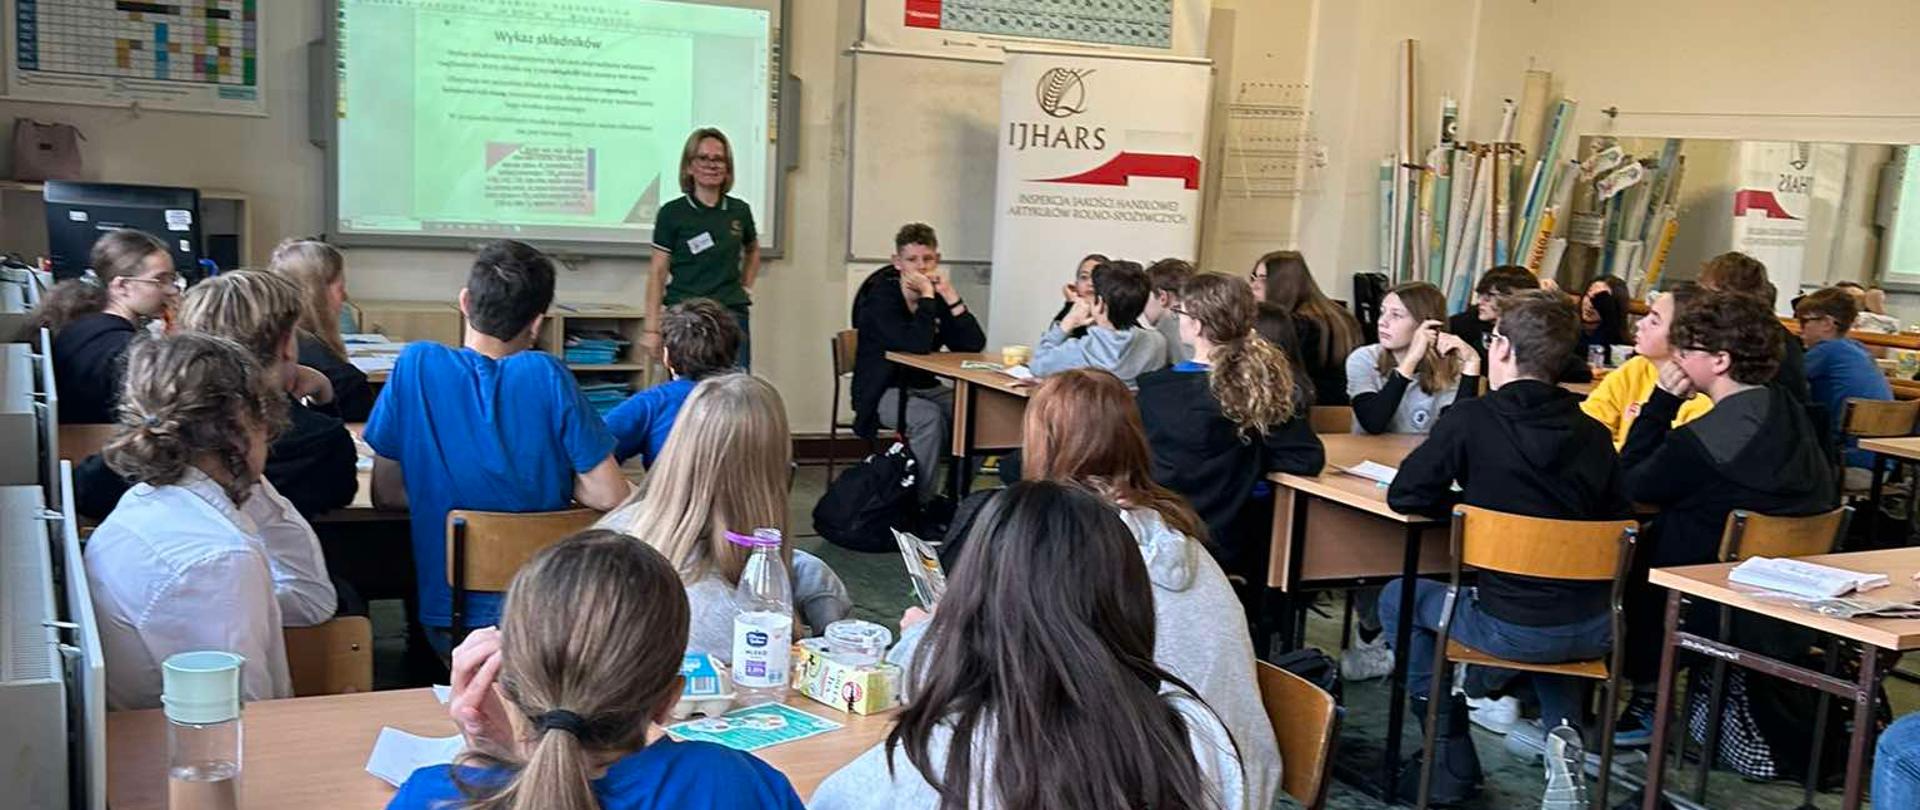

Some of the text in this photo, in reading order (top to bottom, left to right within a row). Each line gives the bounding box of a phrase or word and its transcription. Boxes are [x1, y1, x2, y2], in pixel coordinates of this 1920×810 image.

[494, 30, 602, 49] Wykaz składników
[1009, 122, 1106, 150] IJHARS
[1019, 194, 1179, 212] INSPEKCJA JAKOŚCI HANDLOWEJ
